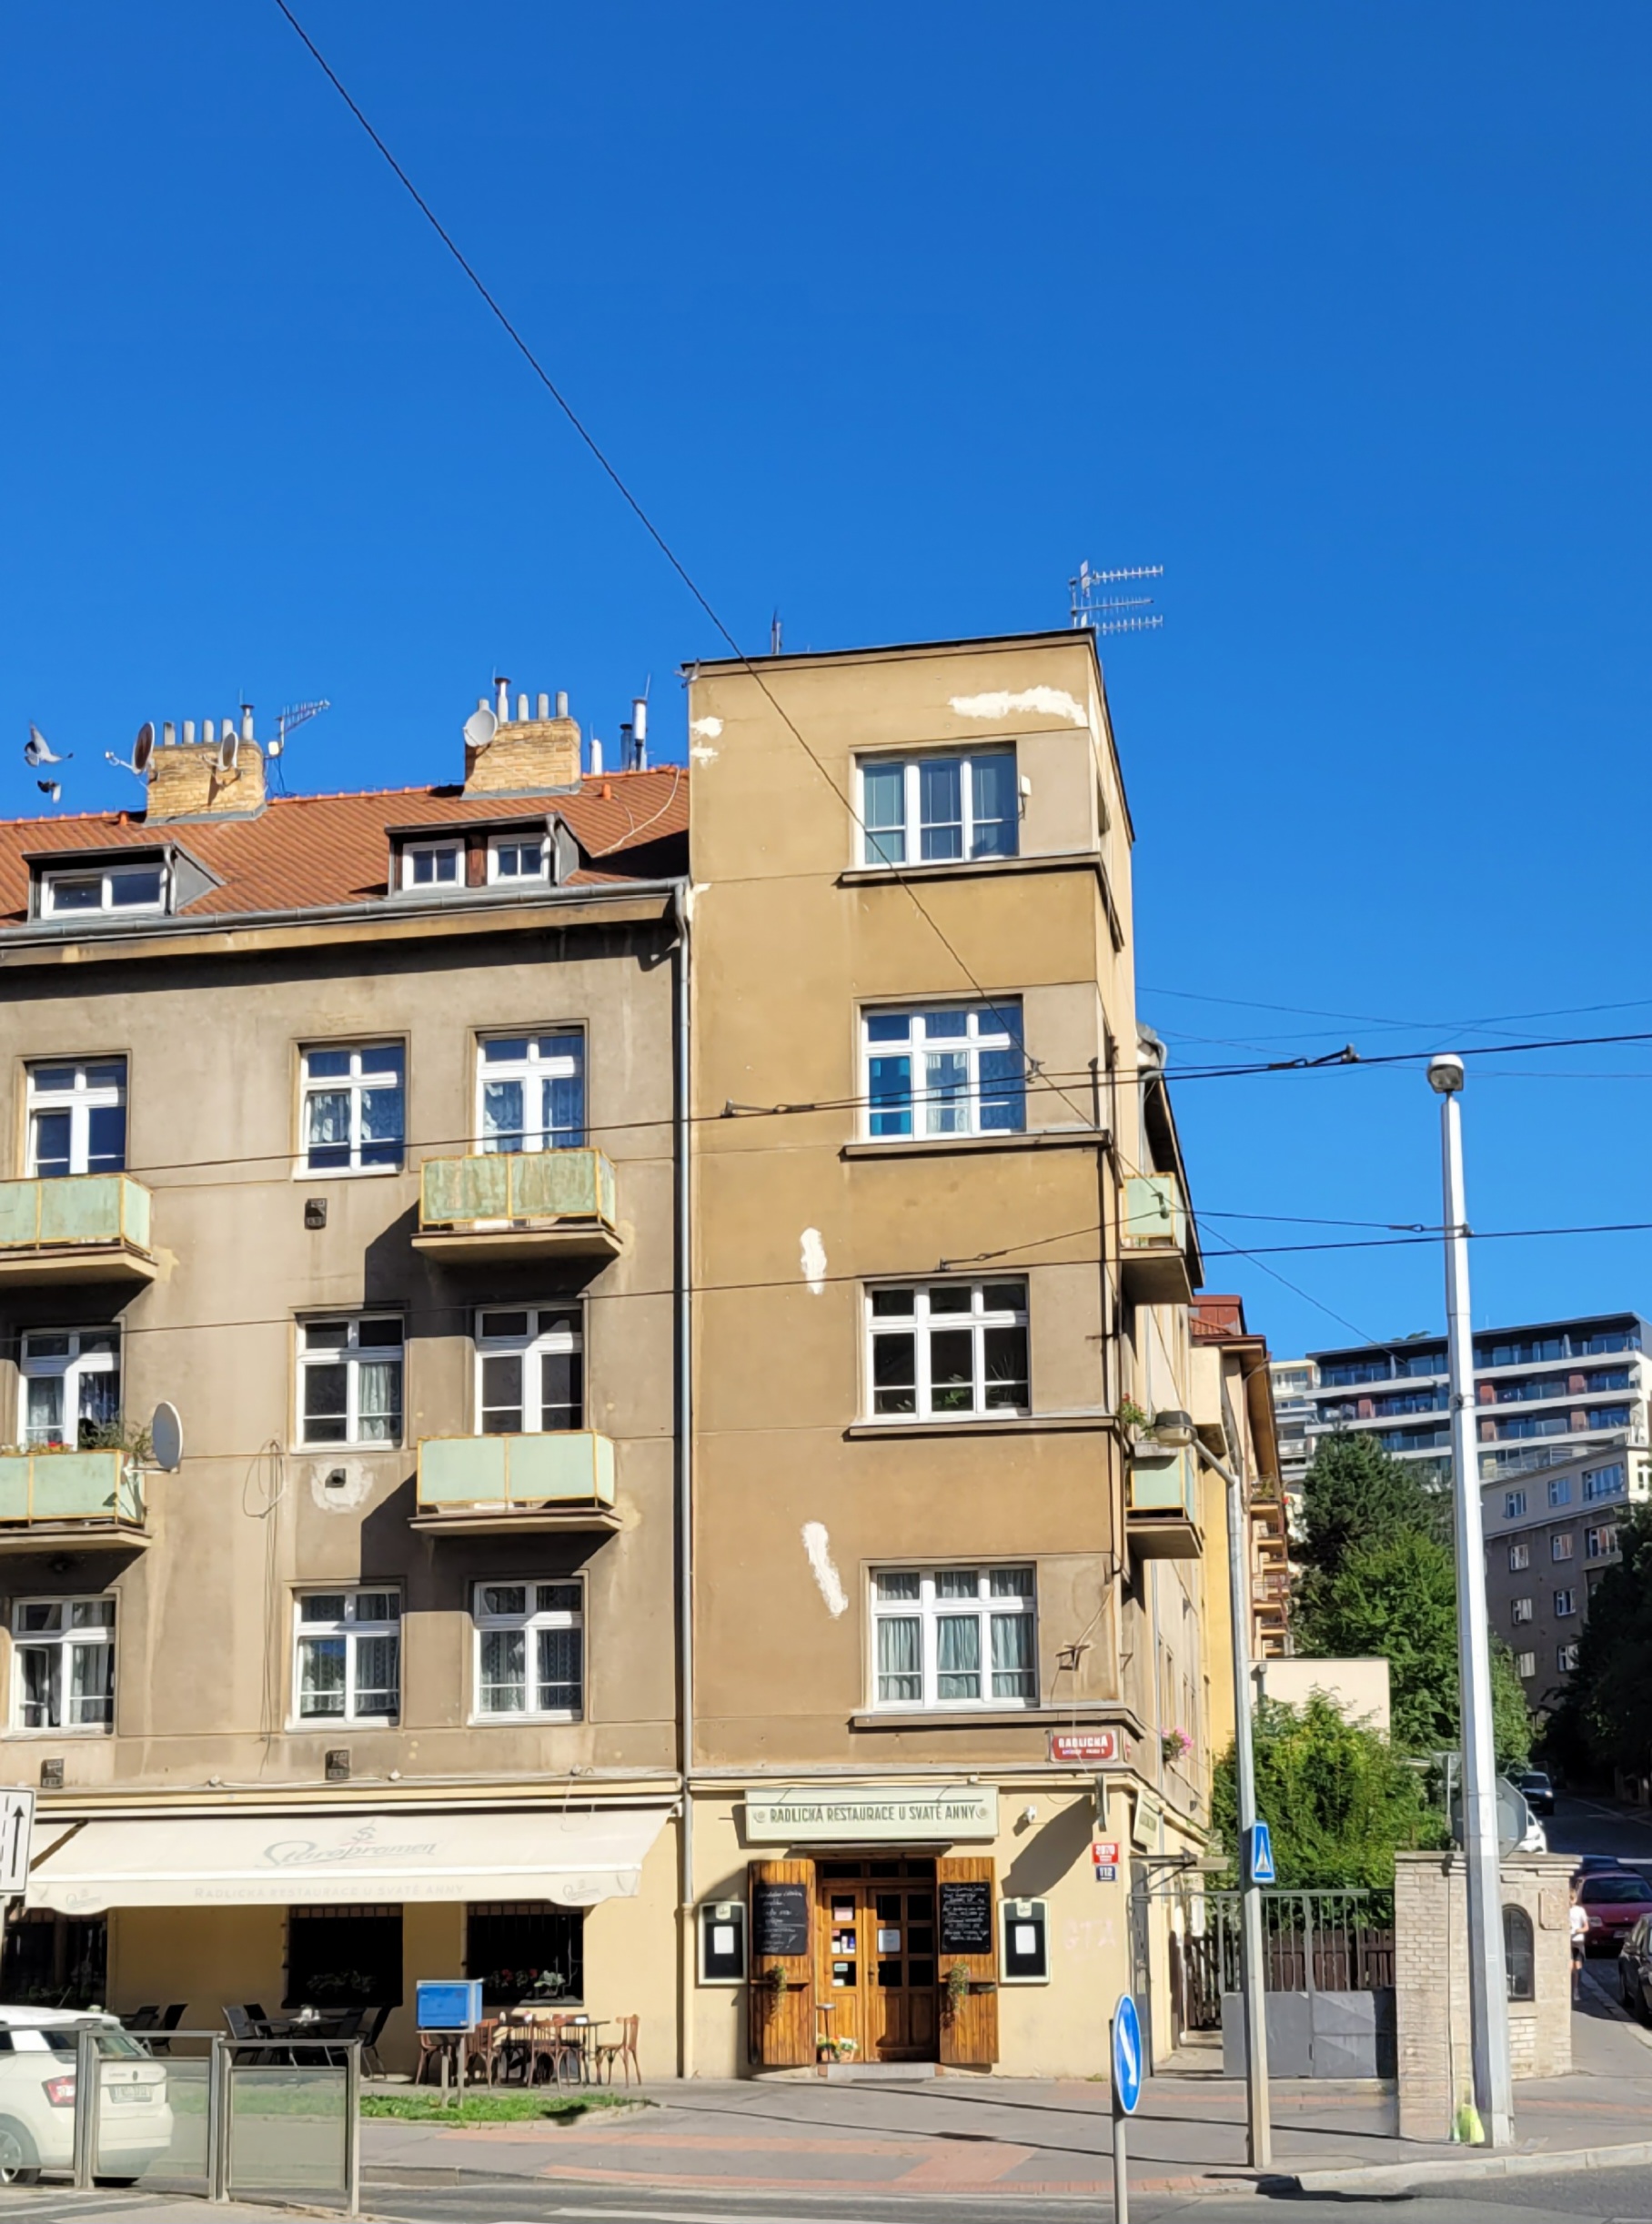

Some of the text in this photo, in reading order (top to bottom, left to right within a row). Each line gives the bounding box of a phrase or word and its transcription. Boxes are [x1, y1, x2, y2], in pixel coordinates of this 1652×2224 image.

[827, 1806, 895, 1821] RESTAURACE
[899, 1806, 906, 1820] U
[945, 1805, 976, 1820] ANNY
[254, 1840, 438, 1867] Staropramen
